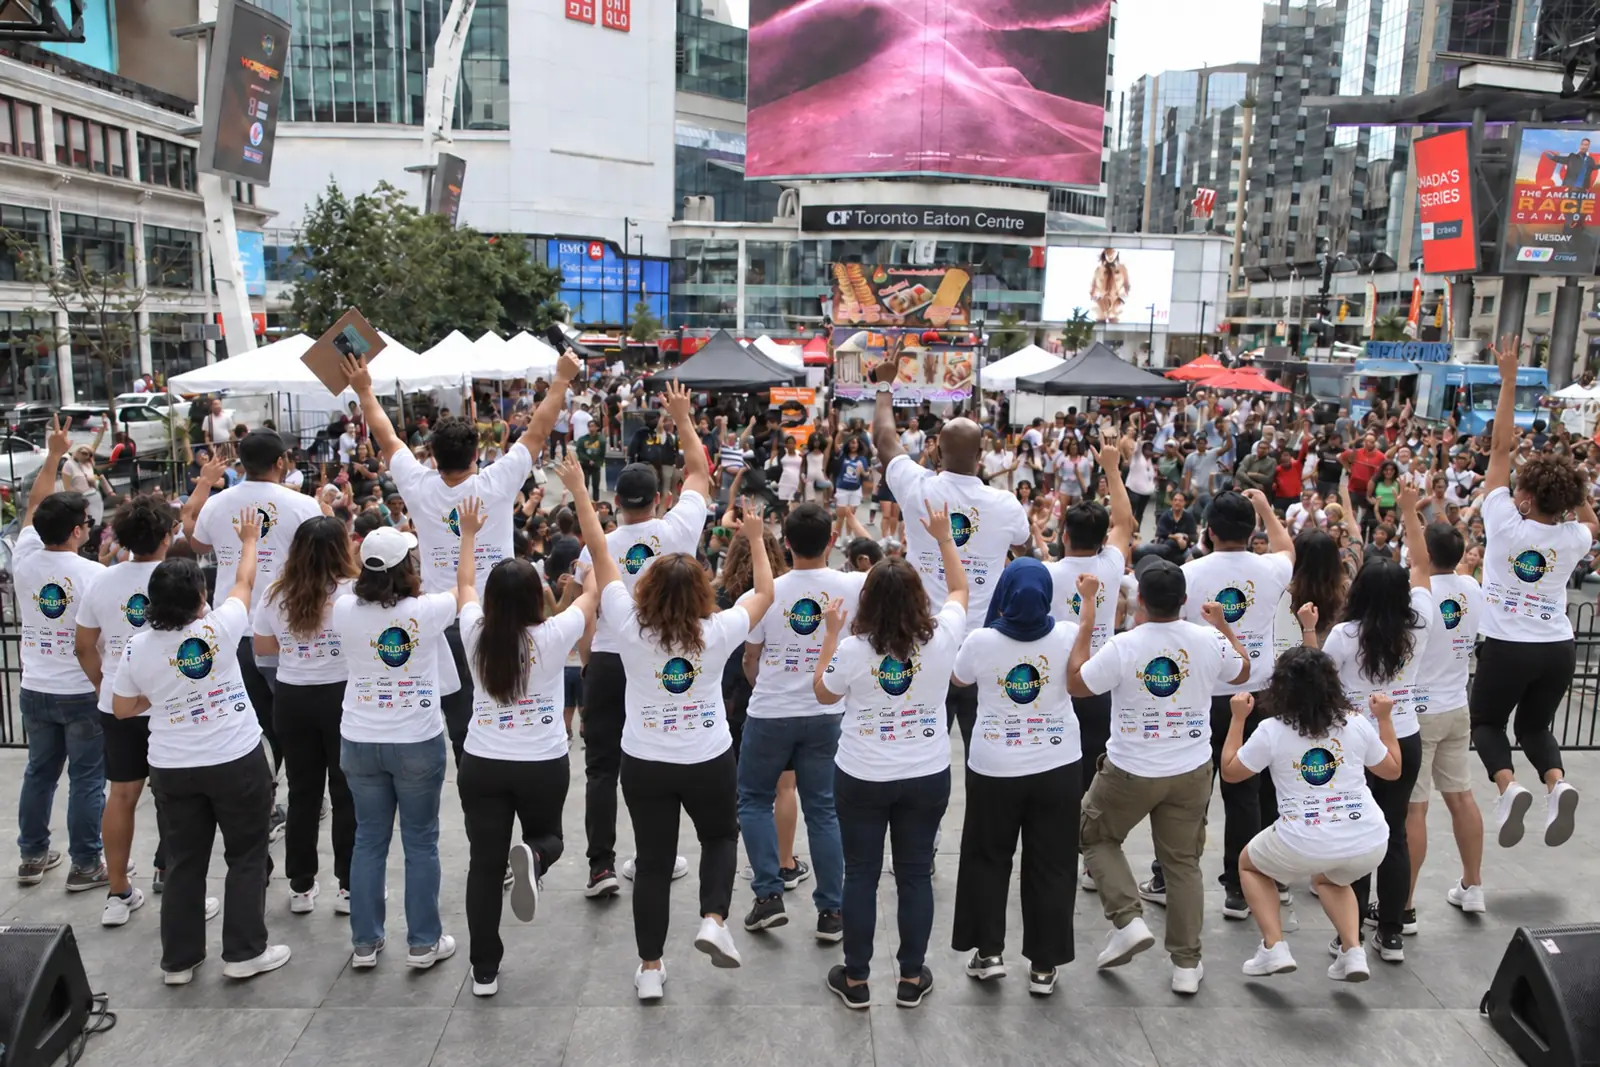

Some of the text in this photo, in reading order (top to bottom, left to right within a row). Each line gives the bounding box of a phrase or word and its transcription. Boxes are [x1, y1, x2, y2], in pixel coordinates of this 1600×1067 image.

[606, 10, 627, 26] QLO
[1417, 169, 1460, 189] NADA'S
[1420, 188, 1460, 208] SERIES
[1520, 190, 1541, 198] THE
[1518, 197, 1595, 214] RACE
[826, 210, 1024, 229] CF Toronto Eaton Centre
[1517, 212, 1592, 222] CANADA
[1534, 233, 1572, 242] TUESDAY
[559, 243, 587, 254] BMO
[1507, 556, 1555, 573] WORLDFEST
[32, 593, 74, 606] WORLDFEST
[369, 637, 419, 653] WORLDFEST
[168, 643, 220, 667] WORLDFEST
[654, 667, 702, 681] WORLDFEST
[871, 663, 922, 681] WORLDFEST
[1135, 669, 1190, 683] WORLDFEST
[996, 676, 1050, 690] WORLDFEST
[228, 691, 245, 701] OMVIC
[1292, 756, 1345, 773] WORLDFEST
